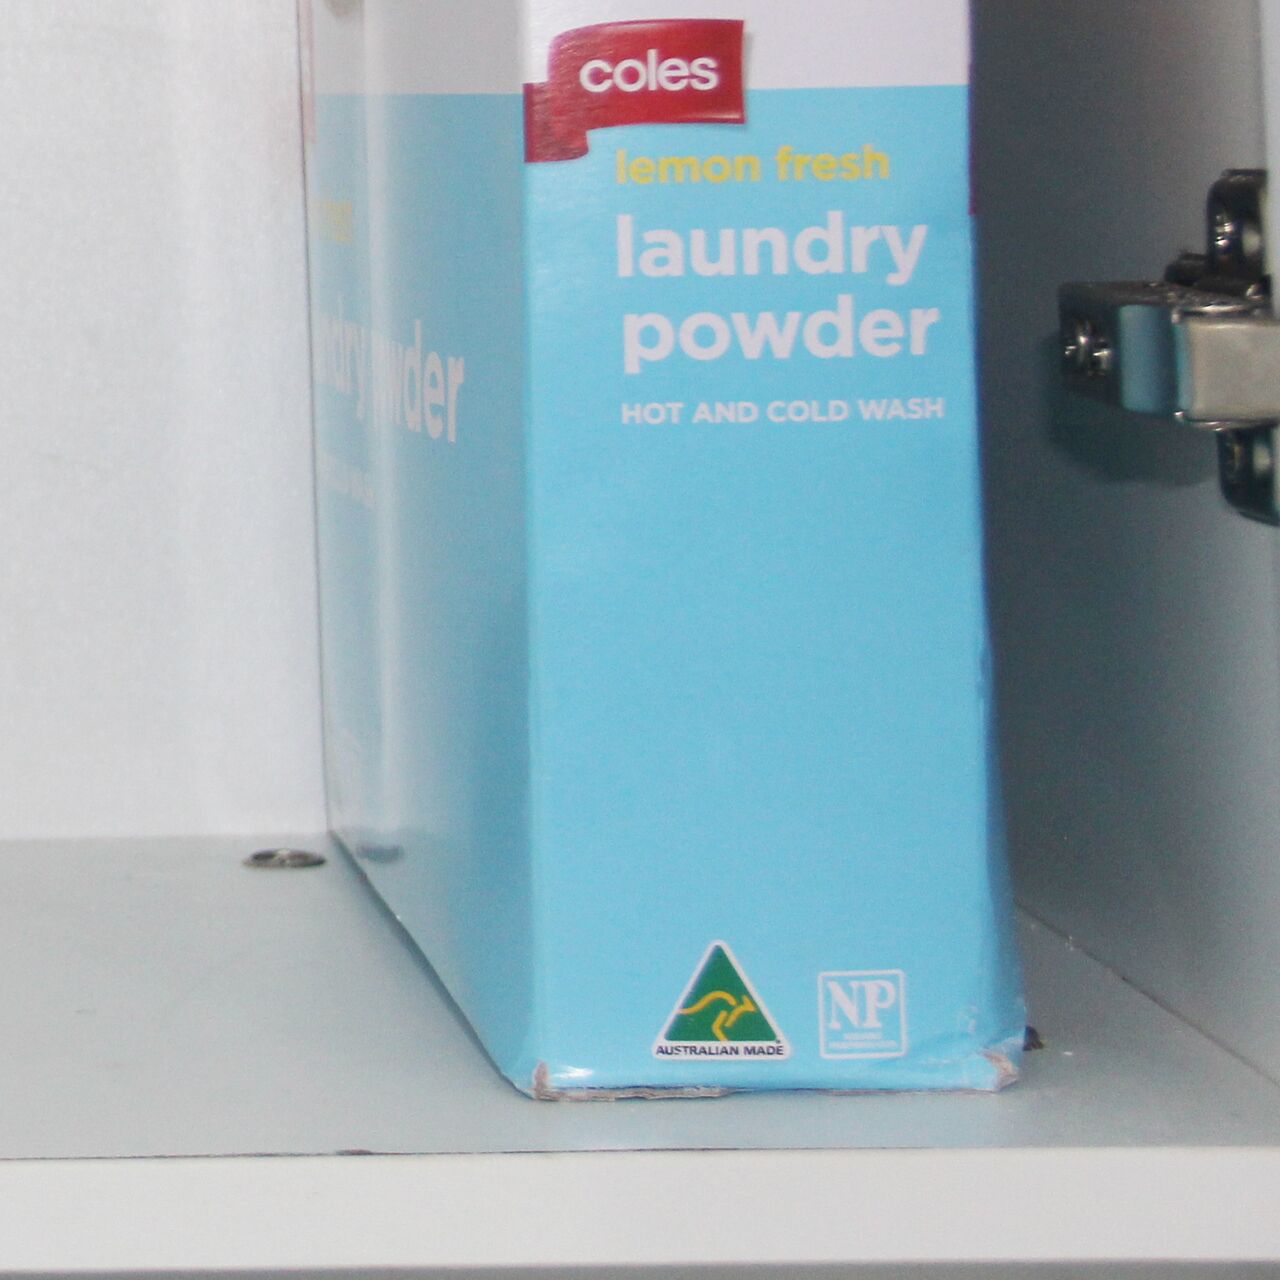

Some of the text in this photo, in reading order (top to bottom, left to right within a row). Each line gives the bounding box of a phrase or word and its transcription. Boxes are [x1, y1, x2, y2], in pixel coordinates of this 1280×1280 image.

[578, 48, 719, 93] coles
[616, 144, 890, 185] lemon fresh
[616, 210, 928, 286] laundry
[623, 293, 940, 374] powder
[621, 396, 945, 424] HOT AND COLD WASH
[827, 979, 896, 1029] NP
[656, 1044, 785, 1056] AUSTRALIAN MADE
